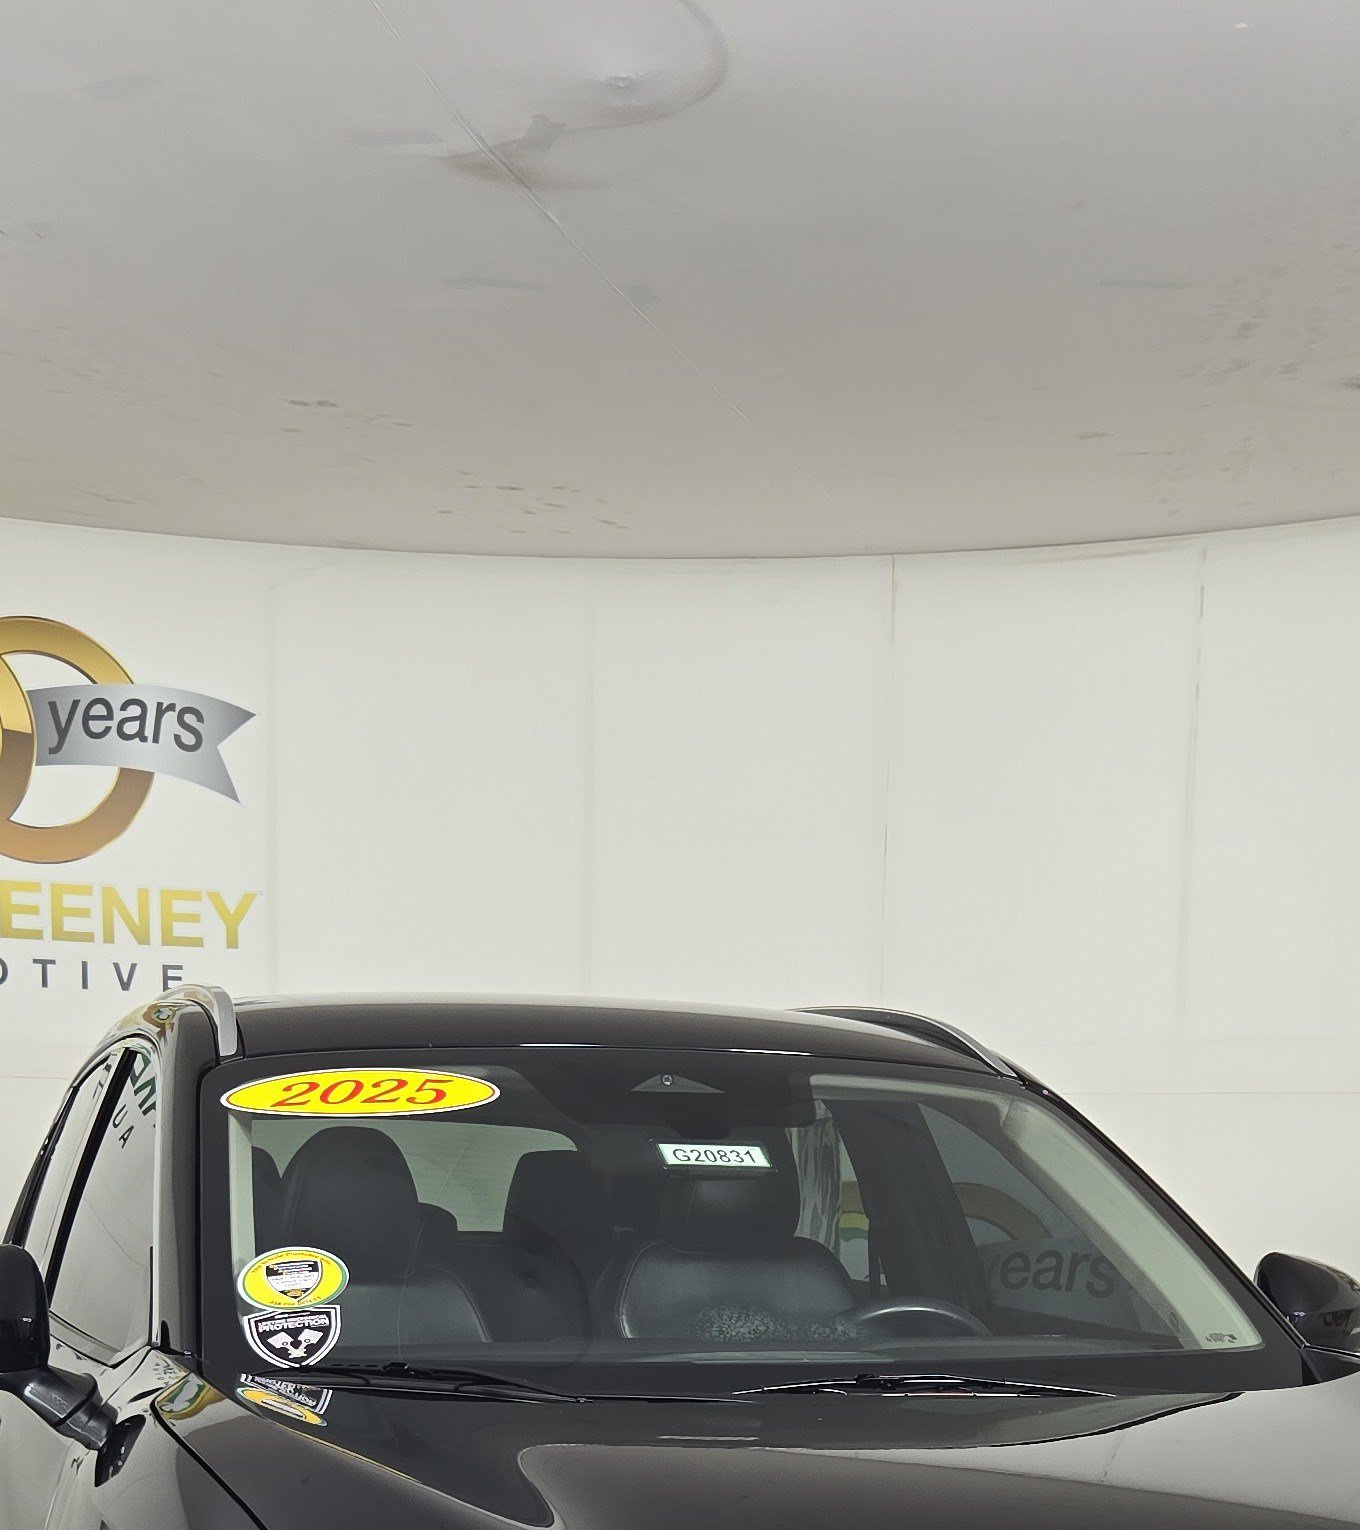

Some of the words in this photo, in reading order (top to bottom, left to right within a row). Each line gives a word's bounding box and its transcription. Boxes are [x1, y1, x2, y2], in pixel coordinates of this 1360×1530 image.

[47, 696, 205, 755] years
[270, 1079, 454, 1107] 2025
[672, 1148, 756, 1164] G20831
[993, 1250, 1116, 1299] ears
[258, 1316, 330, 1332] PROTECTION
